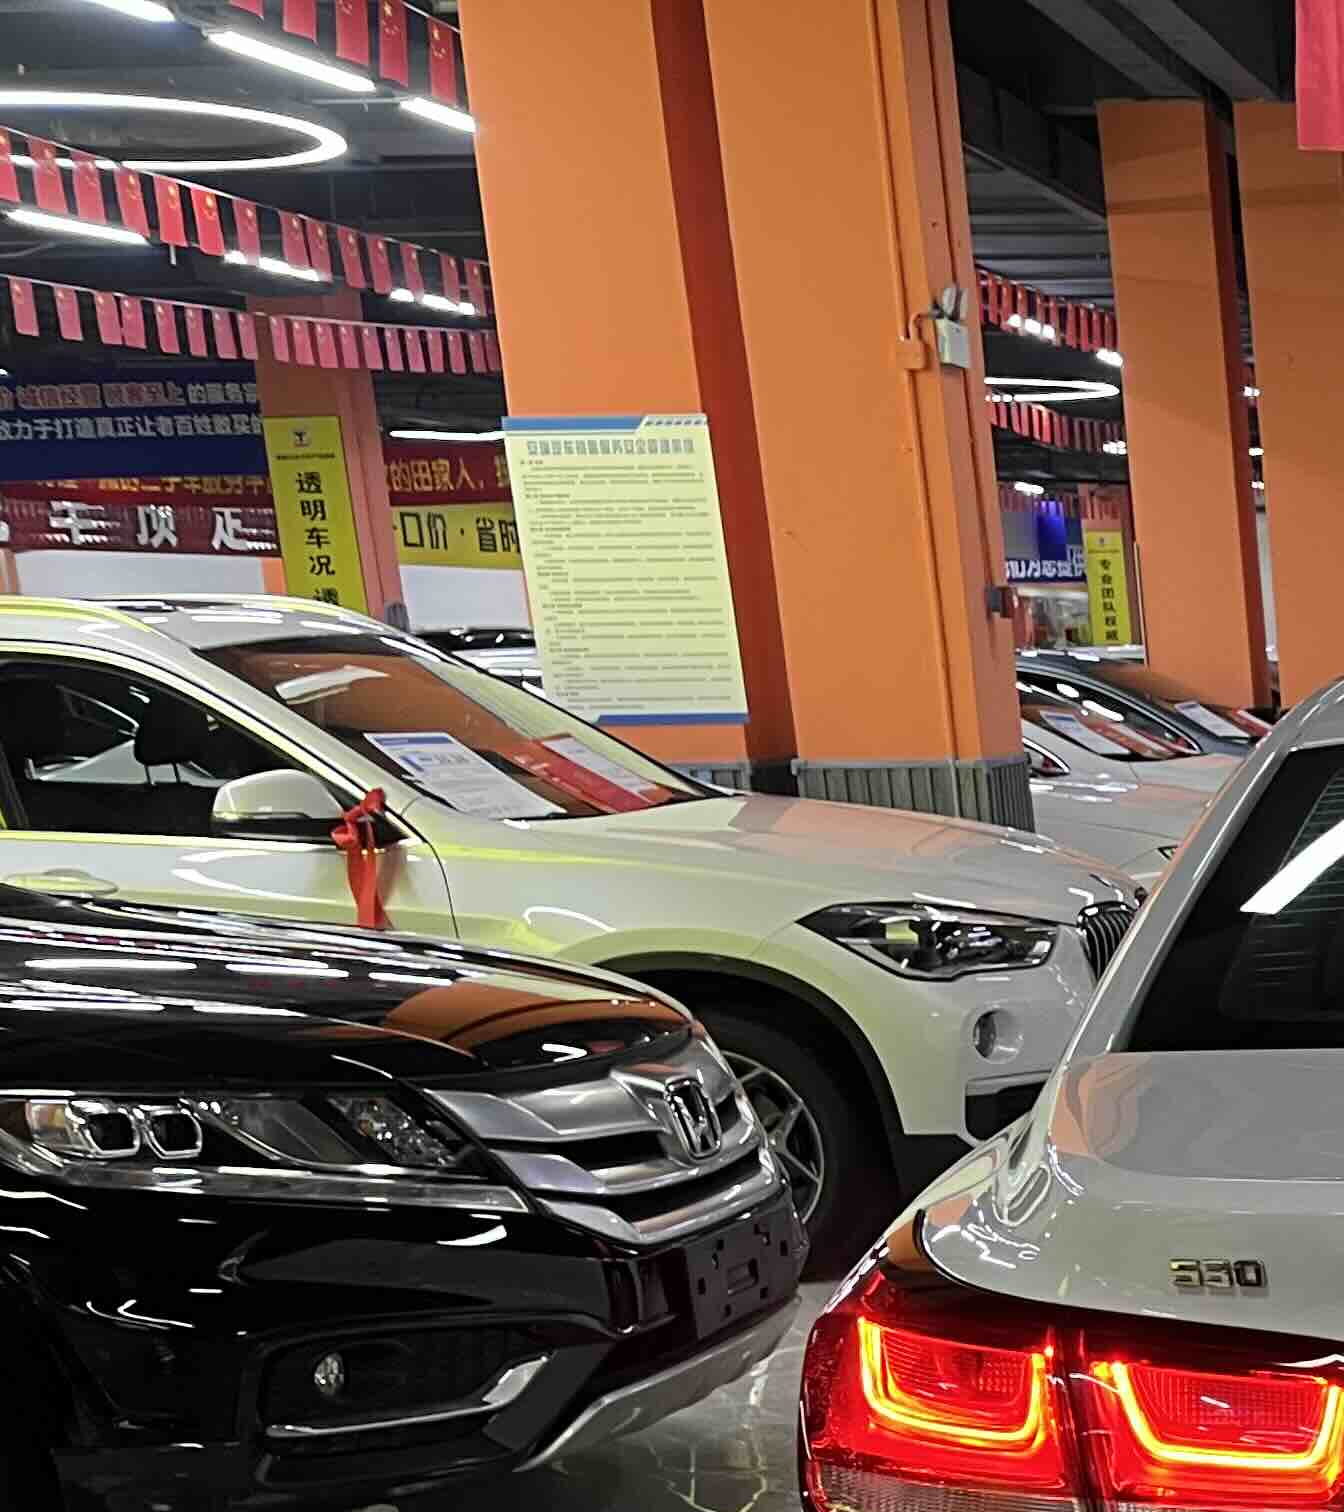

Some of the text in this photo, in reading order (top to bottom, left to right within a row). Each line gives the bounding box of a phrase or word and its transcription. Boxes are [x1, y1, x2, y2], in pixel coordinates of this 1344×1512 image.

[295, 472, 336, 577] 透明车况
[1168, 1258, 1269, 1291] 530
